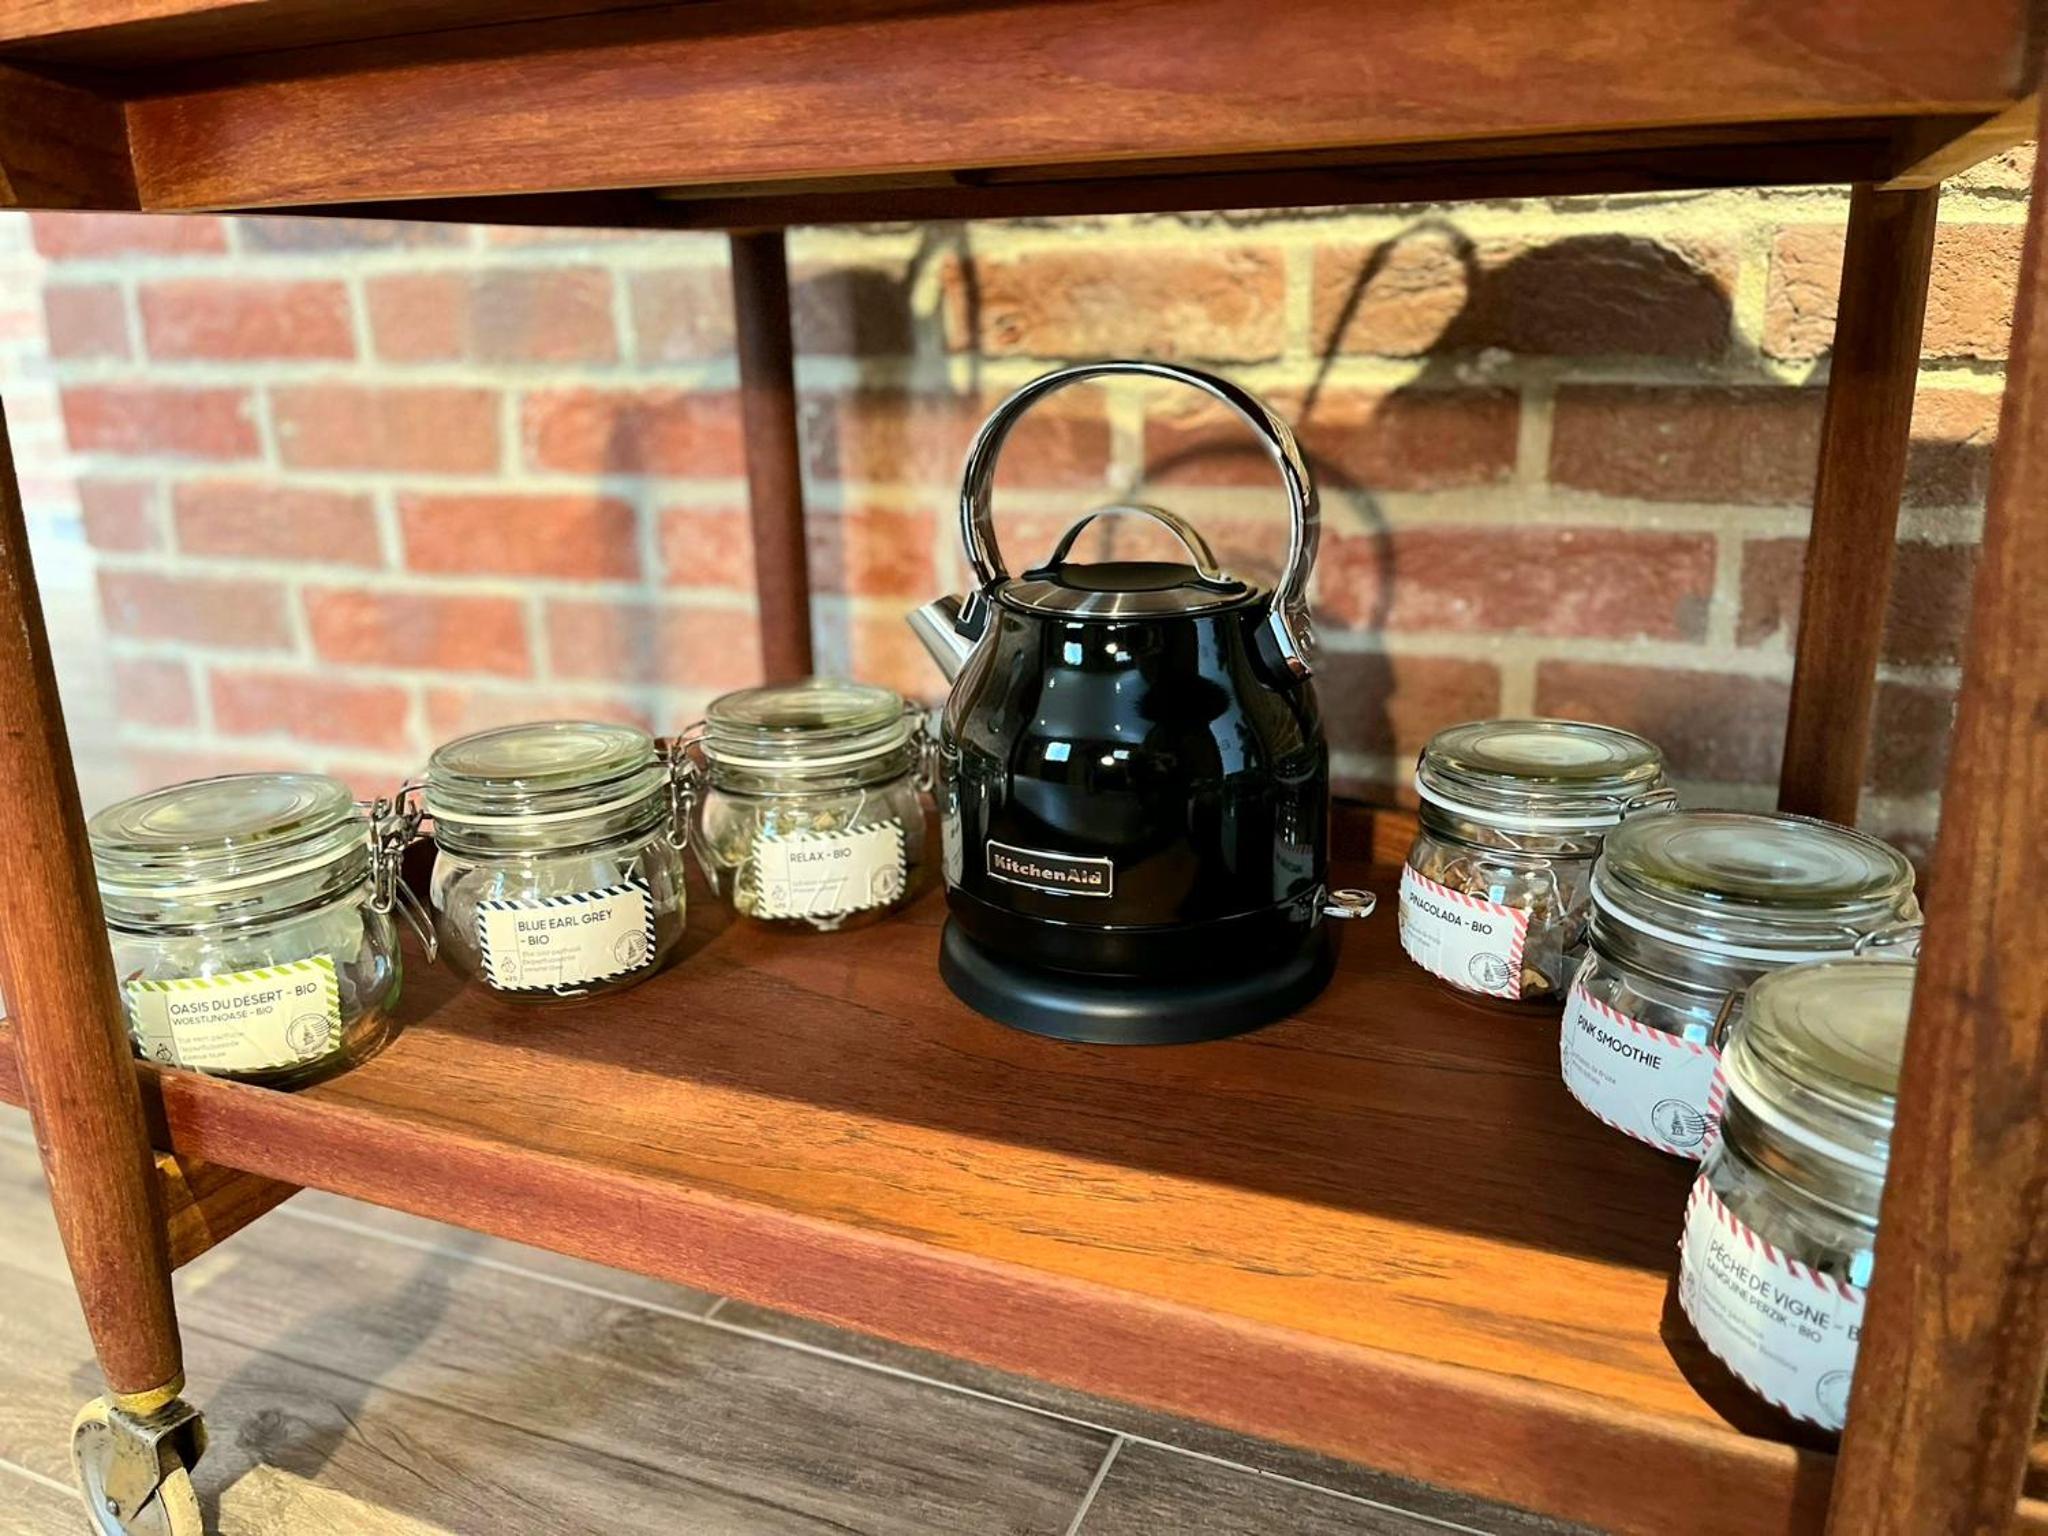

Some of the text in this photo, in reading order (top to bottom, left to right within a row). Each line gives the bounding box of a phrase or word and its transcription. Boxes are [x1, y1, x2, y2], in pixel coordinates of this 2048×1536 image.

[790, 851, 824, 863] RELAX
[833, 847, 852, 859] BIO
[993, 854, 1102, 884] KitchenAid
[518, 909, 613, 932] BLUE EARL GREY
[1471, 921, 1493, 935] BIO
[528, 934, 550, 946] BIO
[170, 1001, 209, 1015] OASIS
[212, 999, 231, 1012] DU
[295, 982, 317, 996] BIO
[256, 1006, 273, 1016] BIO
[1577, 1014, 1597, 1037] PINK
[1596, 1029, 1662, 1070] SMOOTHIE
[1748, 1273, 1771, 1298] DE
[1774, 1287, 1830, 1330] VIGNE
[1798, 1324, 1822, 1343] BIO
